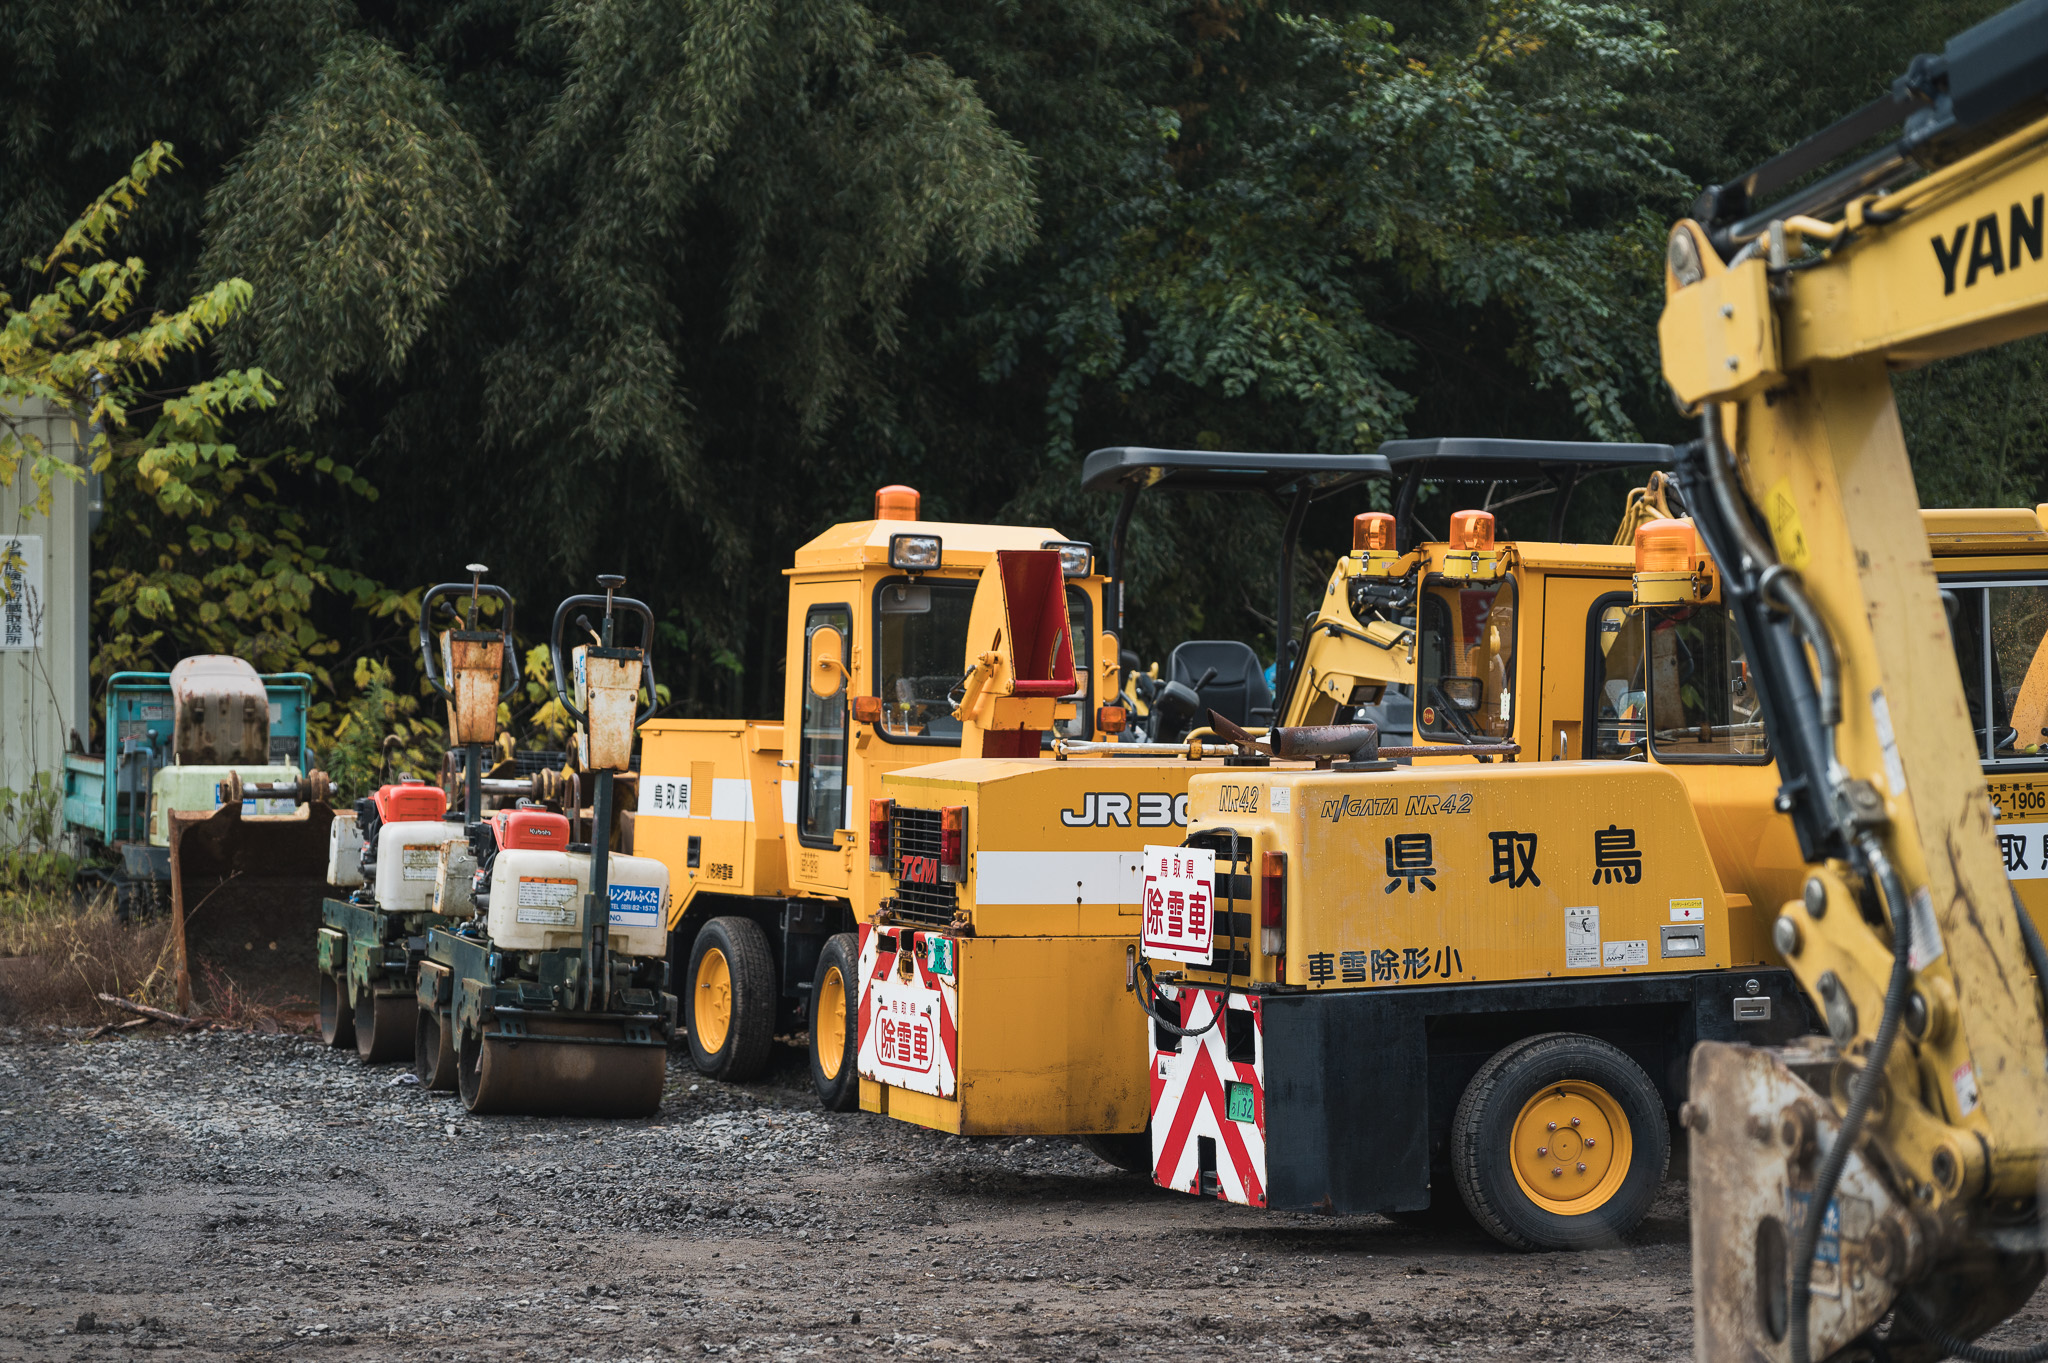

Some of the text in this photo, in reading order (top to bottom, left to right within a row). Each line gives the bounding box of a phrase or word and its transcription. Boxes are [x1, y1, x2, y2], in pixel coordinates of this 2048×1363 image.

[1930, 192, 2044, 296] YAN
[653, 783, 688, 810] 鳥取県
[1061, 792, 1132, 827] JR
[1219, 785, 1259, 813] NR42
[1405, 793, 1473, 816] NR42
[1988, 791, 2046, 811] 2-1906
[901, 855, 938, 884] TCM
[1160, 858, 1194, 879] 鳥取県
[610, 888, 658, 904] レンタルふくた
[1147, 887, 1207, 941] 除雪車
[881, 1018, 928, 1065] 除雪車
